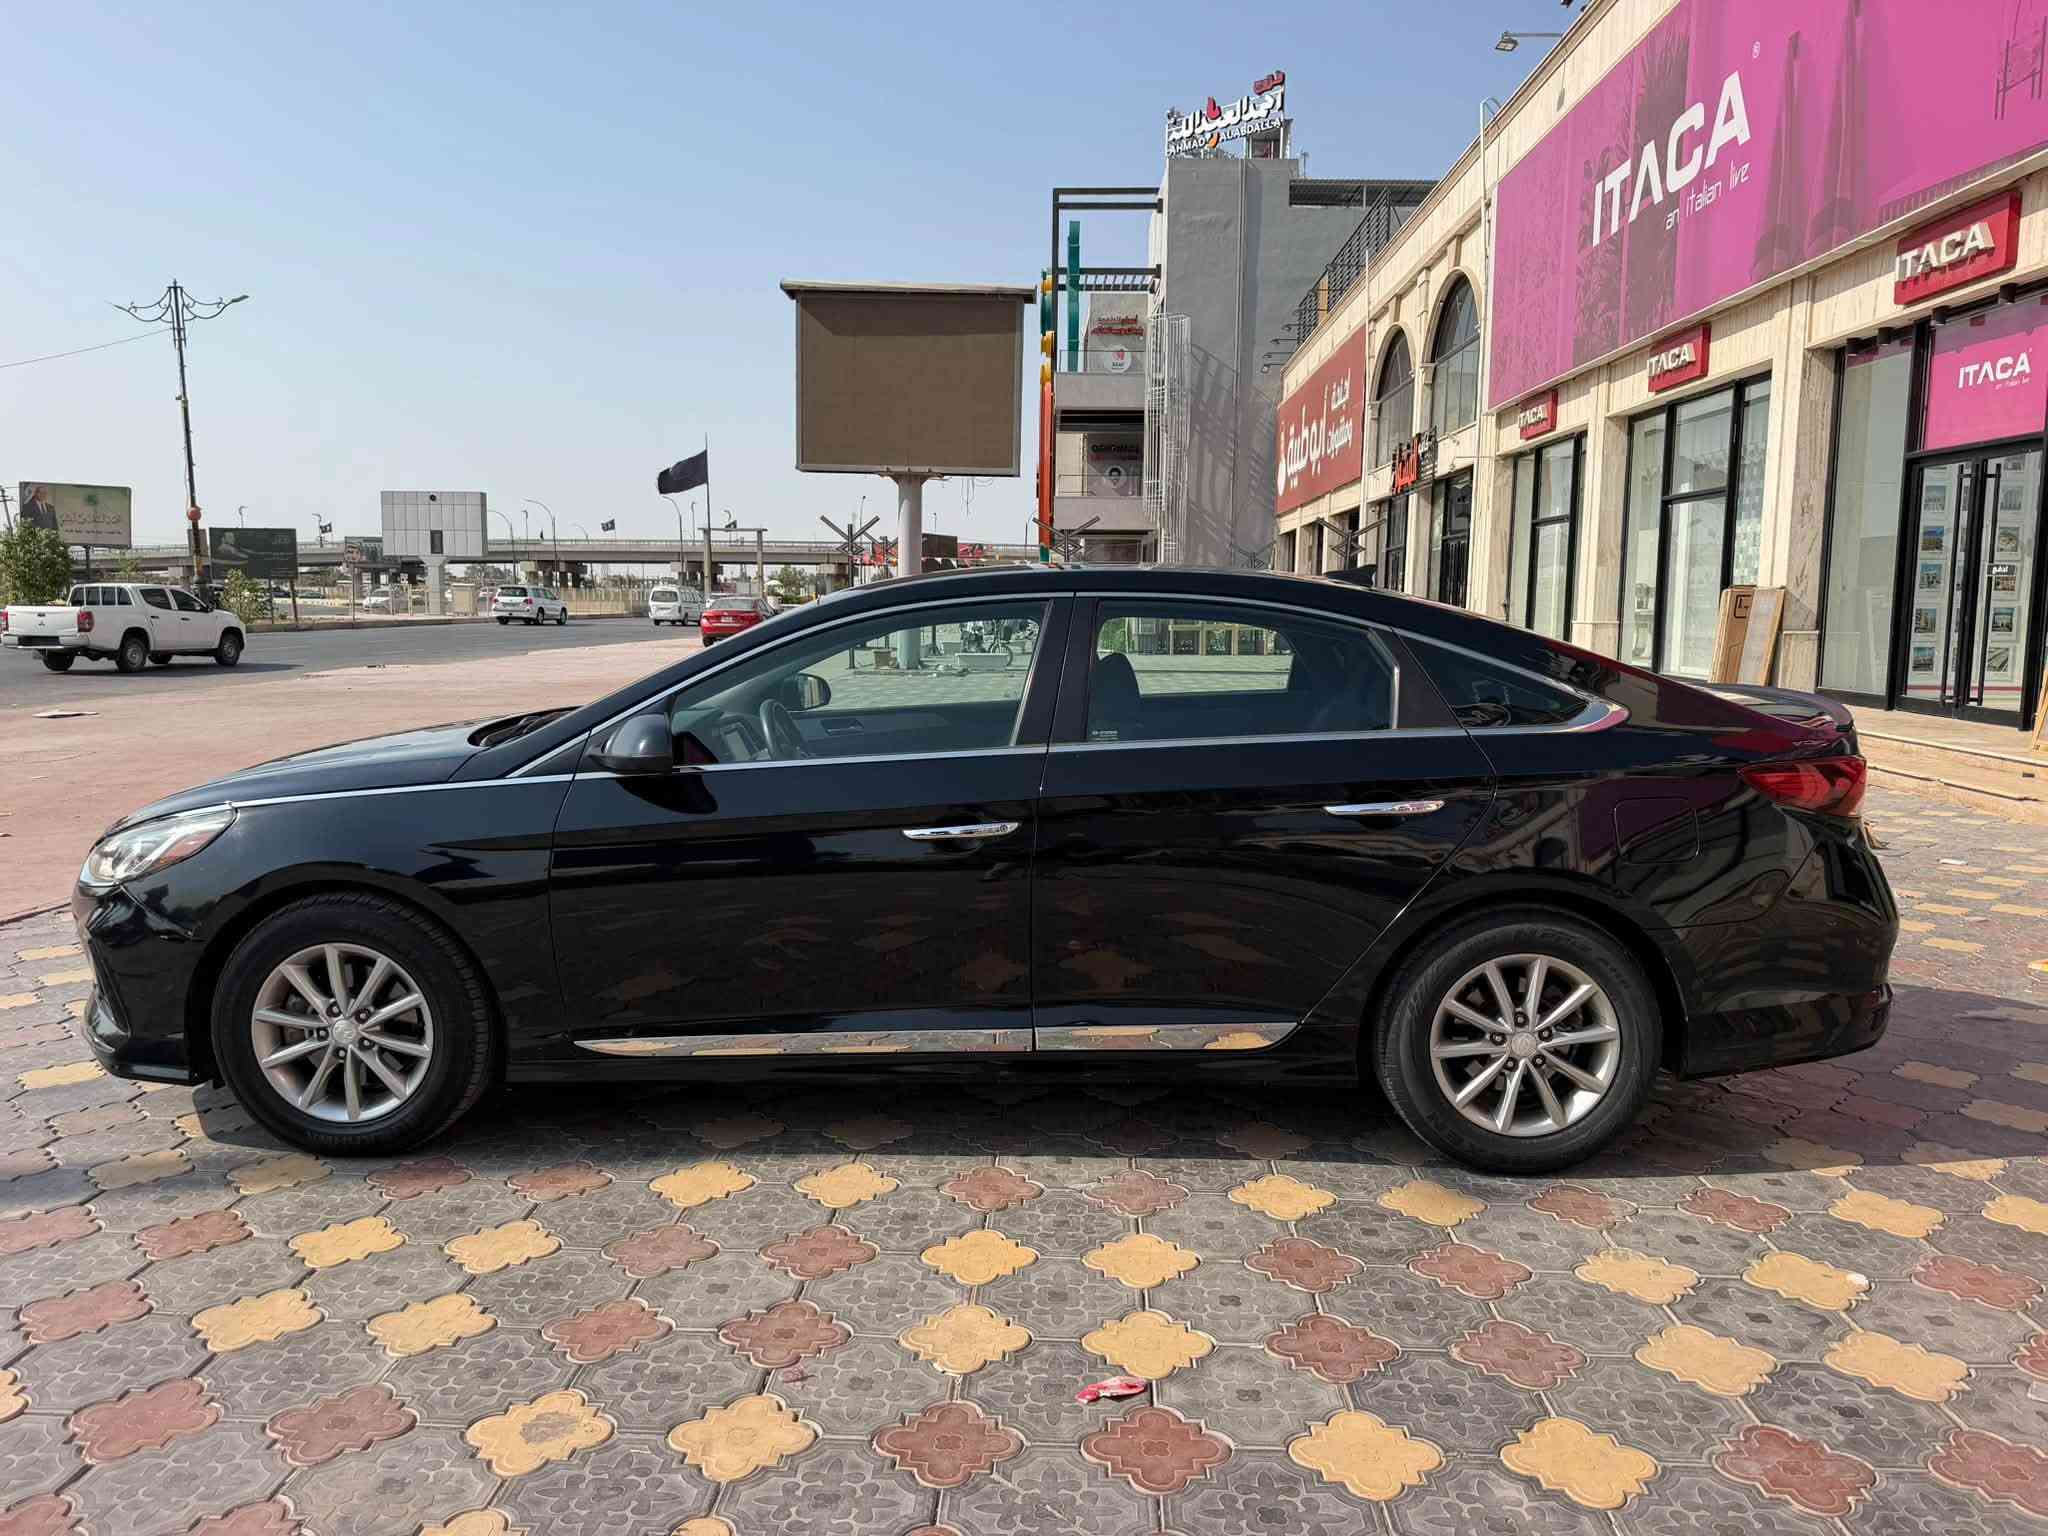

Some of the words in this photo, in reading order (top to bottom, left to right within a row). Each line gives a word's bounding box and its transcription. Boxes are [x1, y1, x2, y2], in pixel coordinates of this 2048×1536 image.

[1593, 71, 1751, 248] ITACA
[1665, 208, 1680, 230] an
[1895, 222, 1993, 281] ITACA
[1646, 343, 1694, 377] ITACA
[1957, 352, 2031, 389] ITACA
